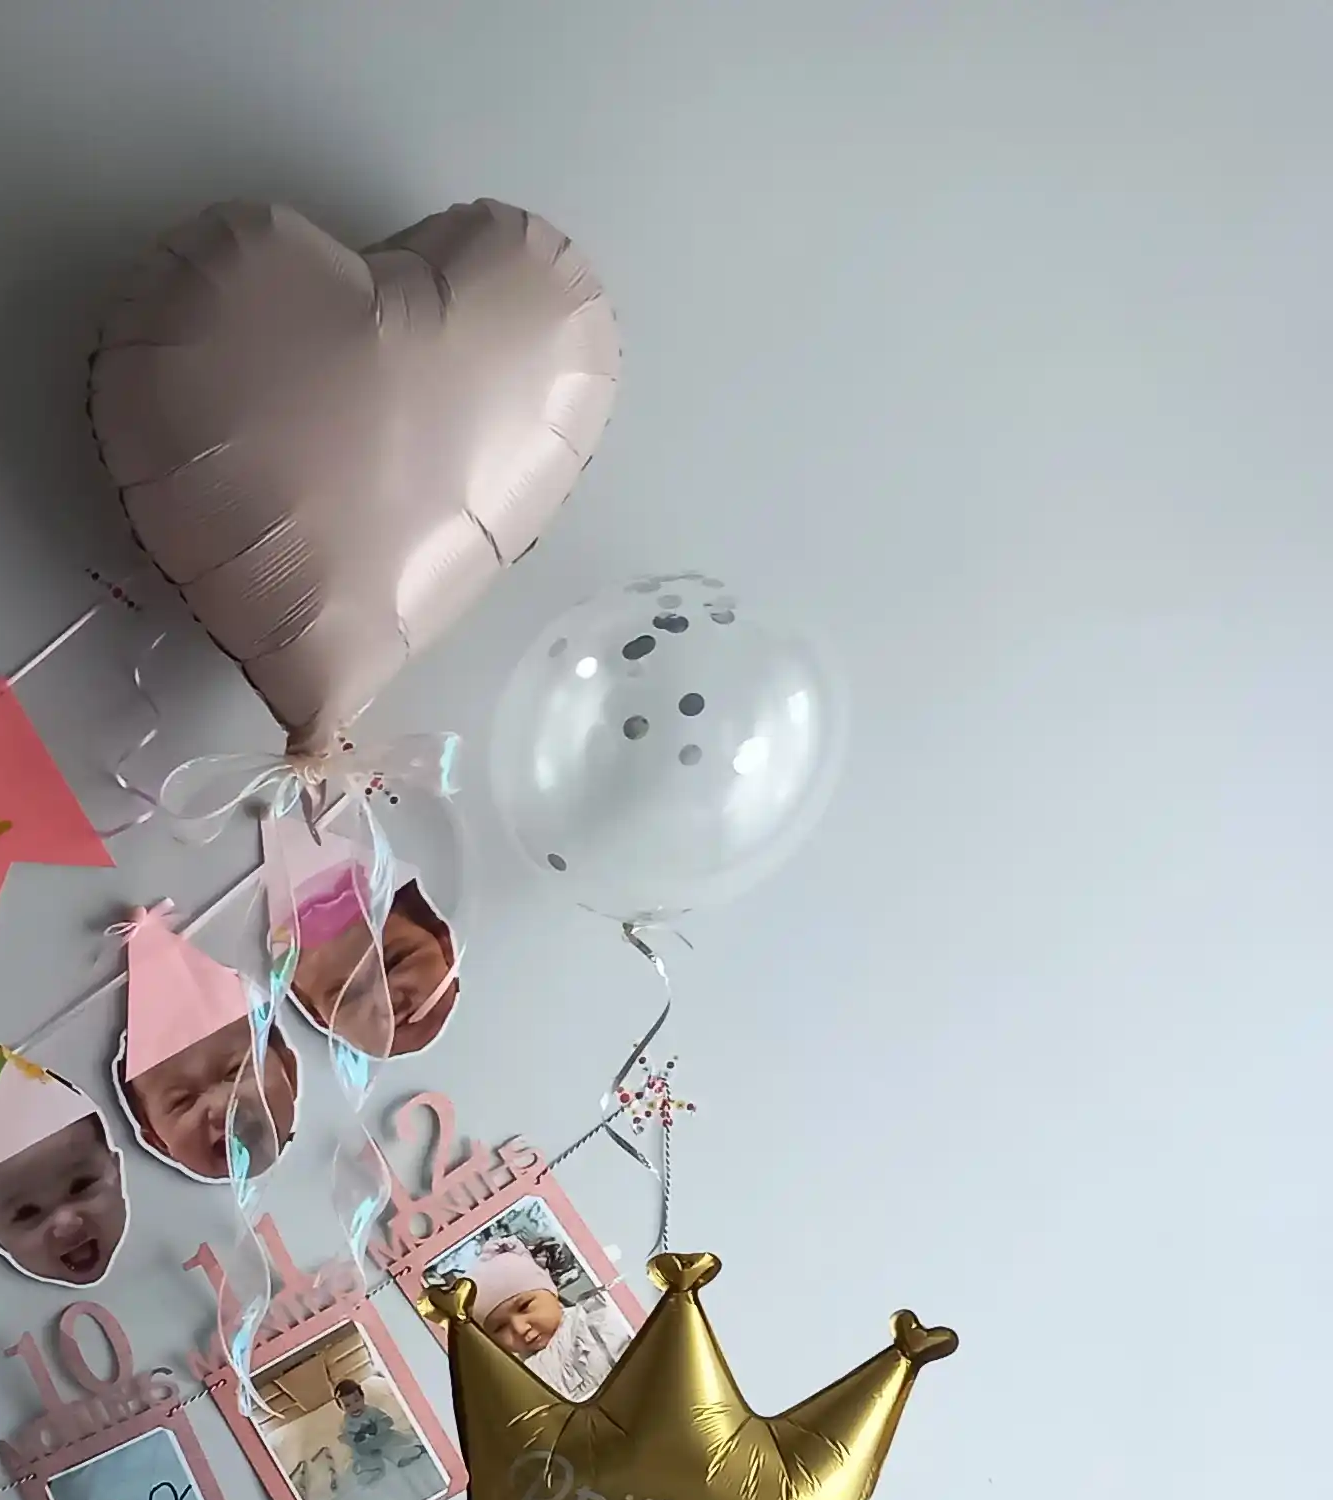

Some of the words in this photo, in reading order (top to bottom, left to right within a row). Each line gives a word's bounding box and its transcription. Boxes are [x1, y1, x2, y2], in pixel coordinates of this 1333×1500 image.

[182, 1213, 305, 1322] 11
[186, 1260, 367, 1382] MNTHS
[3, 1301, 133, 1416] 10
